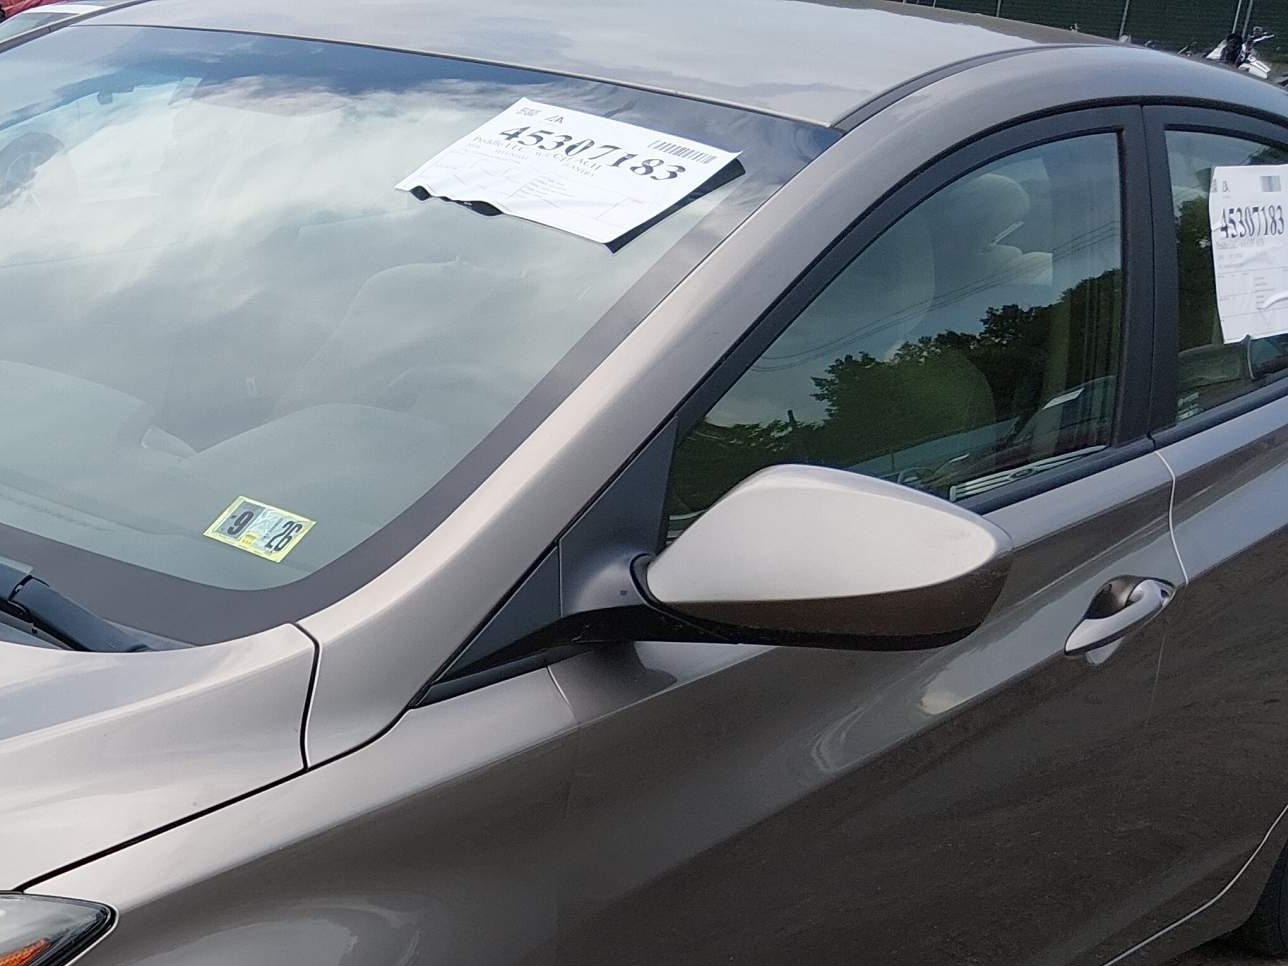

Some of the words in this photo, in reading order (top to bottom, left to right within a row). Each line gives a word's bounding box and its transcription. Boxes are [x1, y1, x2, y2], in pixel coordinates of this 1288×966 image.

[499, 125, 687, 181] 45307183
[1220, 204, 1285, 239] 45307183
[264, 520, 303, 552] 26
